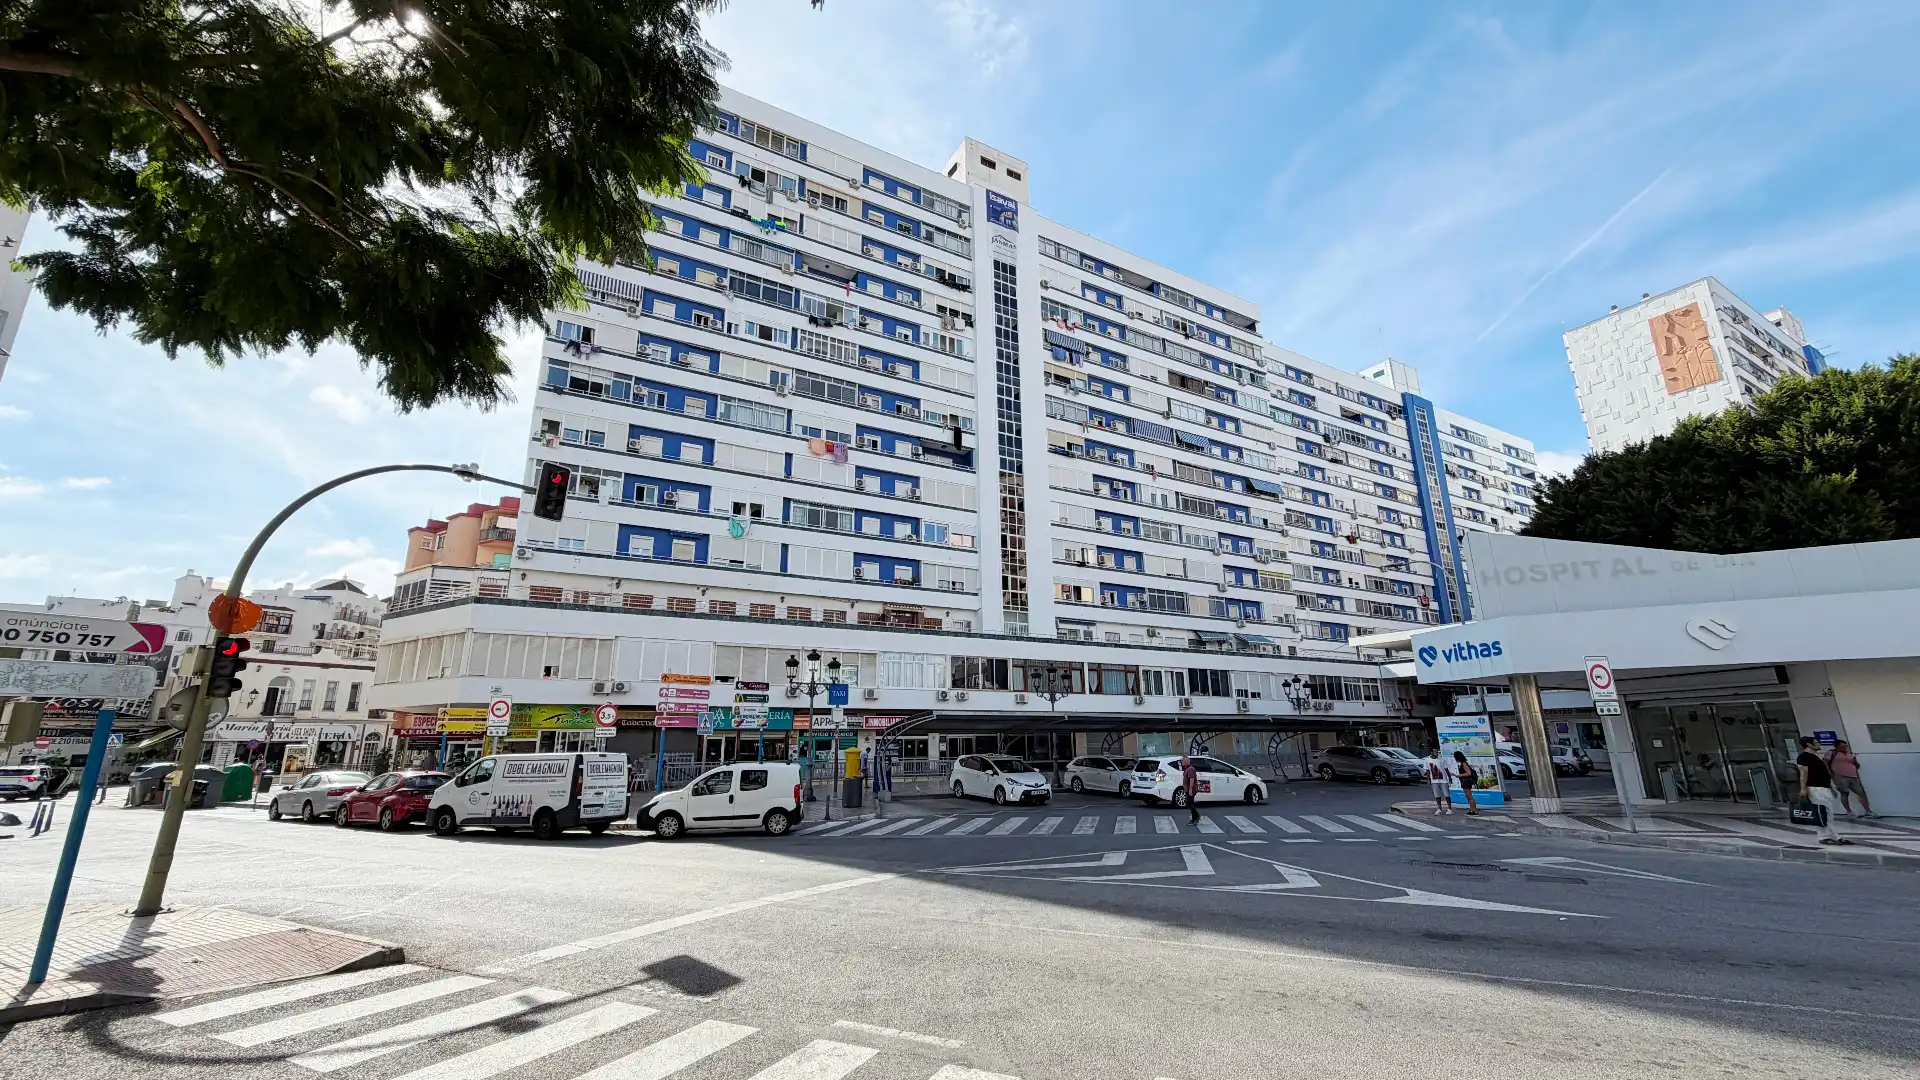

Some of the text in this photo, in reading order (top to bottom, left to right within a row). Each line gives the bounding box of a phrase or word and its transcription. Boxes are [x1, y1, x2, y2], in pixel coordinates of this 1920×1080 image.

[989, 191, 1016, 209] isaval
[1481, 556, 1657, 588] HOSPITAL
[7, 617, 89, 631] anúnciate
[0, 628, 117, 648] 0 750 757
[1441, 640, 1503, 664] vithas
[506, 762, 566, 775] DOBLEMAGNUM
[1793, 809, 1813, 817] EA7
